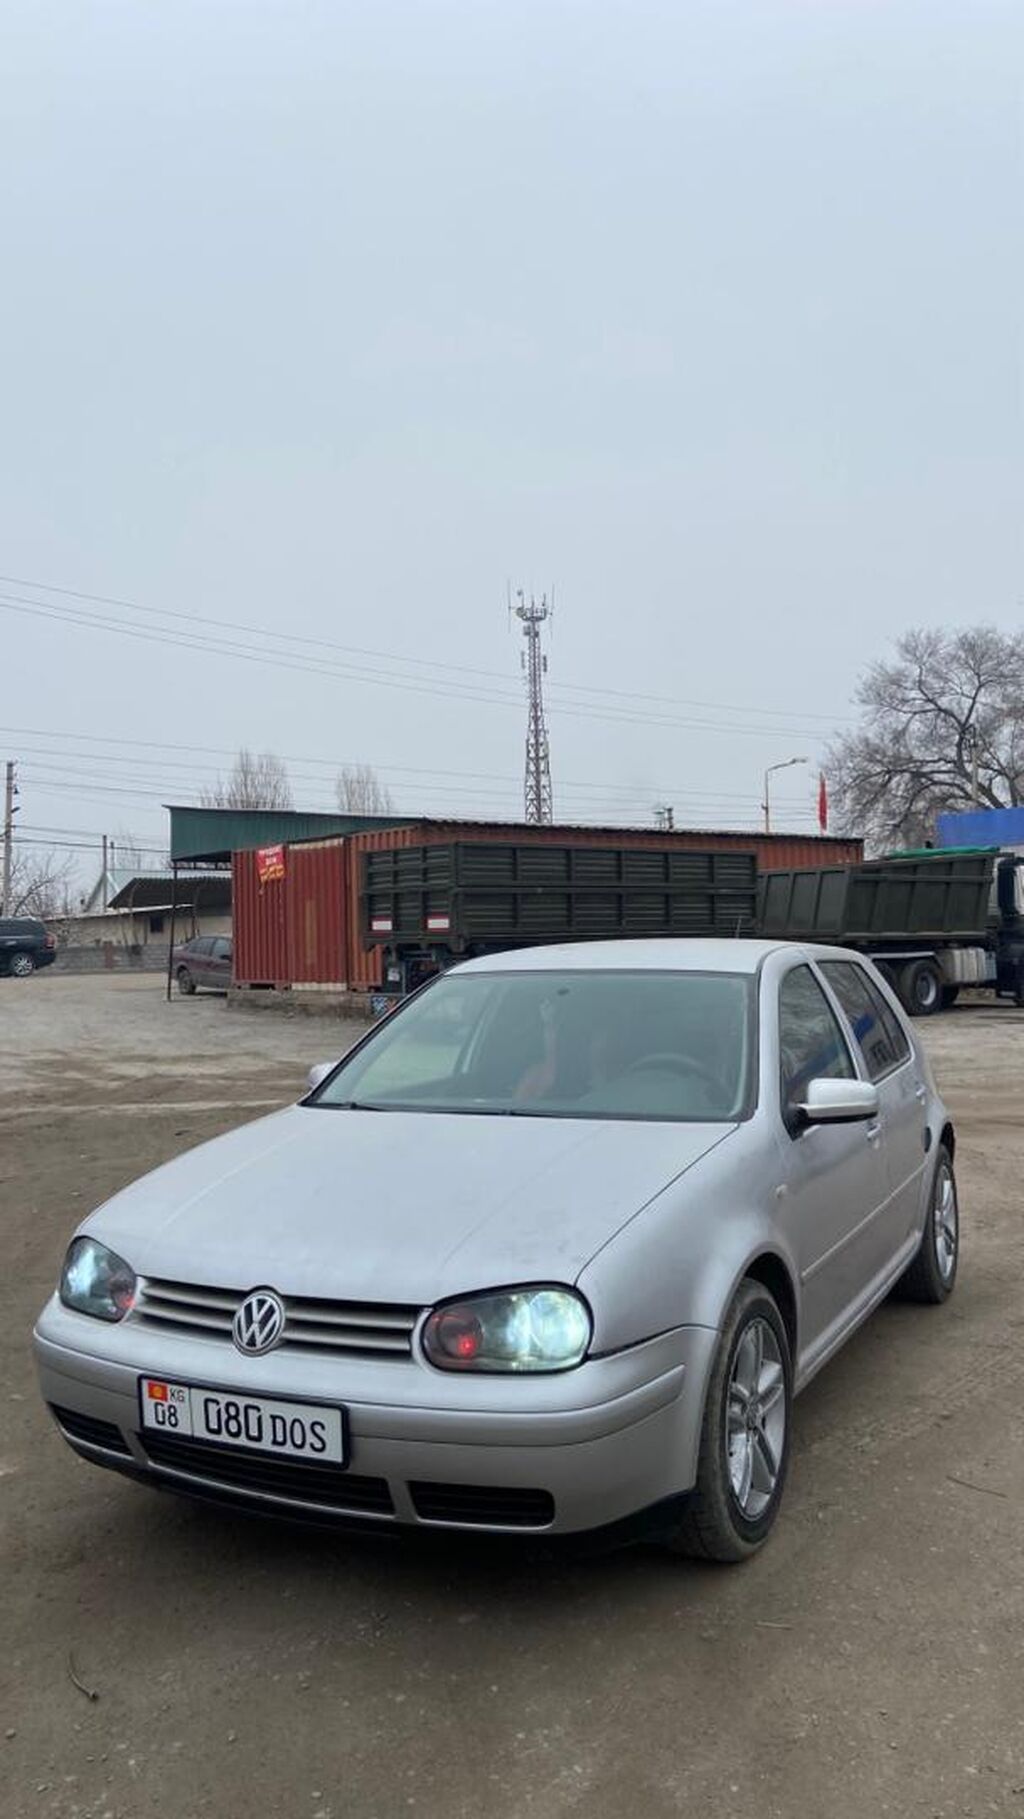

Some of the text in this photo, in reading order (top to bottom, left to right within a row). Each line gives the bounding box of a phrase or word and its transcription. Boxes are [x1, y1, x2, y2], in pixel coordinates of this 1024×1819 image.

[170, 1388, 185, 1403] KG
[154, 1402, 179, 1428] 08
[204, 1398, 326, 1452] 080 DOS
